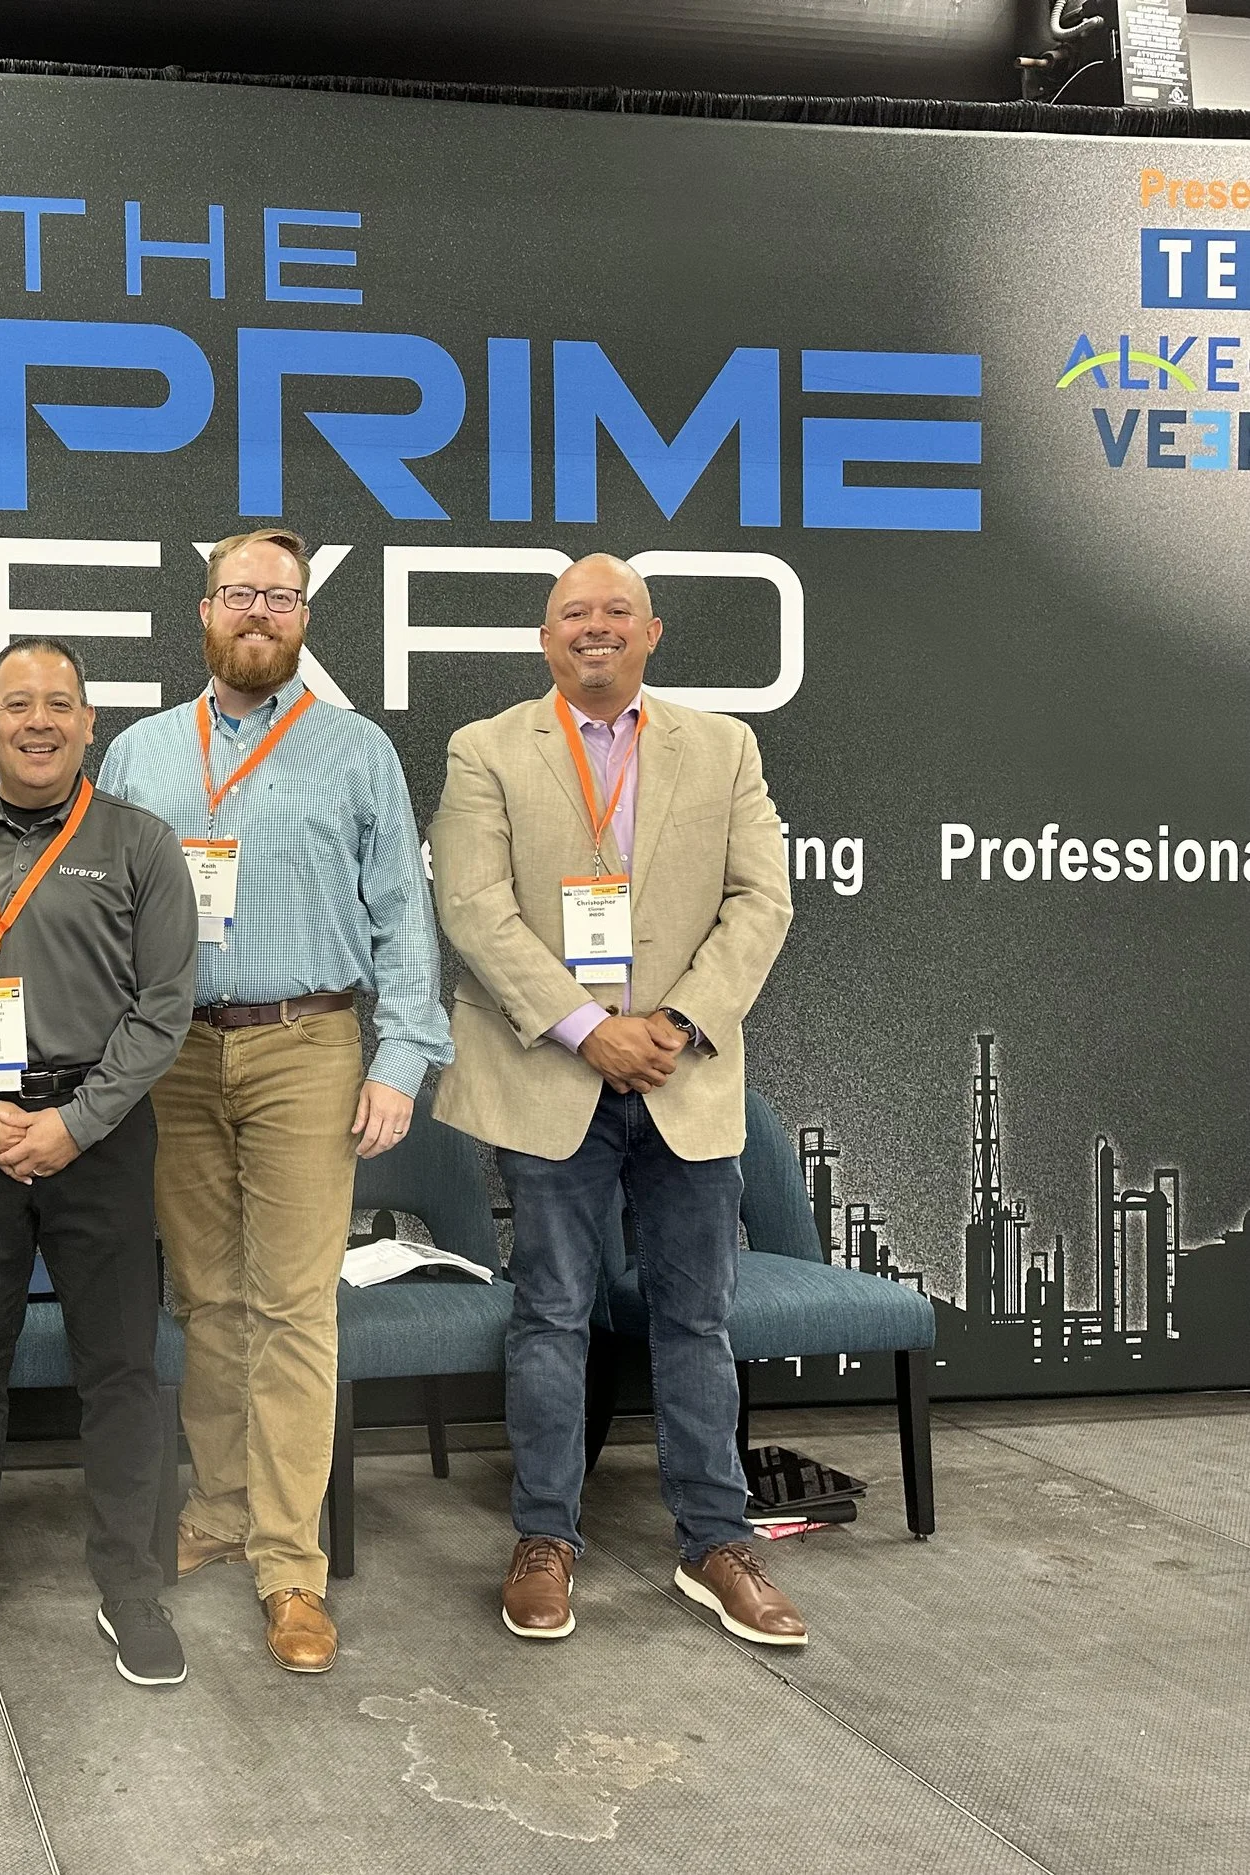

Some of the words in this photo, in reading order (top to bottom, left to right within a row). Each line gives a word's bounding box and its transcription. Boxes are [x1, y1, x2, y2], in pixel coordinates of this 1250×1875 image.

[1061, 333, 1250, 392] ALKE
[58, 864, 107, 880] kuraray
[941, 822, 1250, 884] Profession
